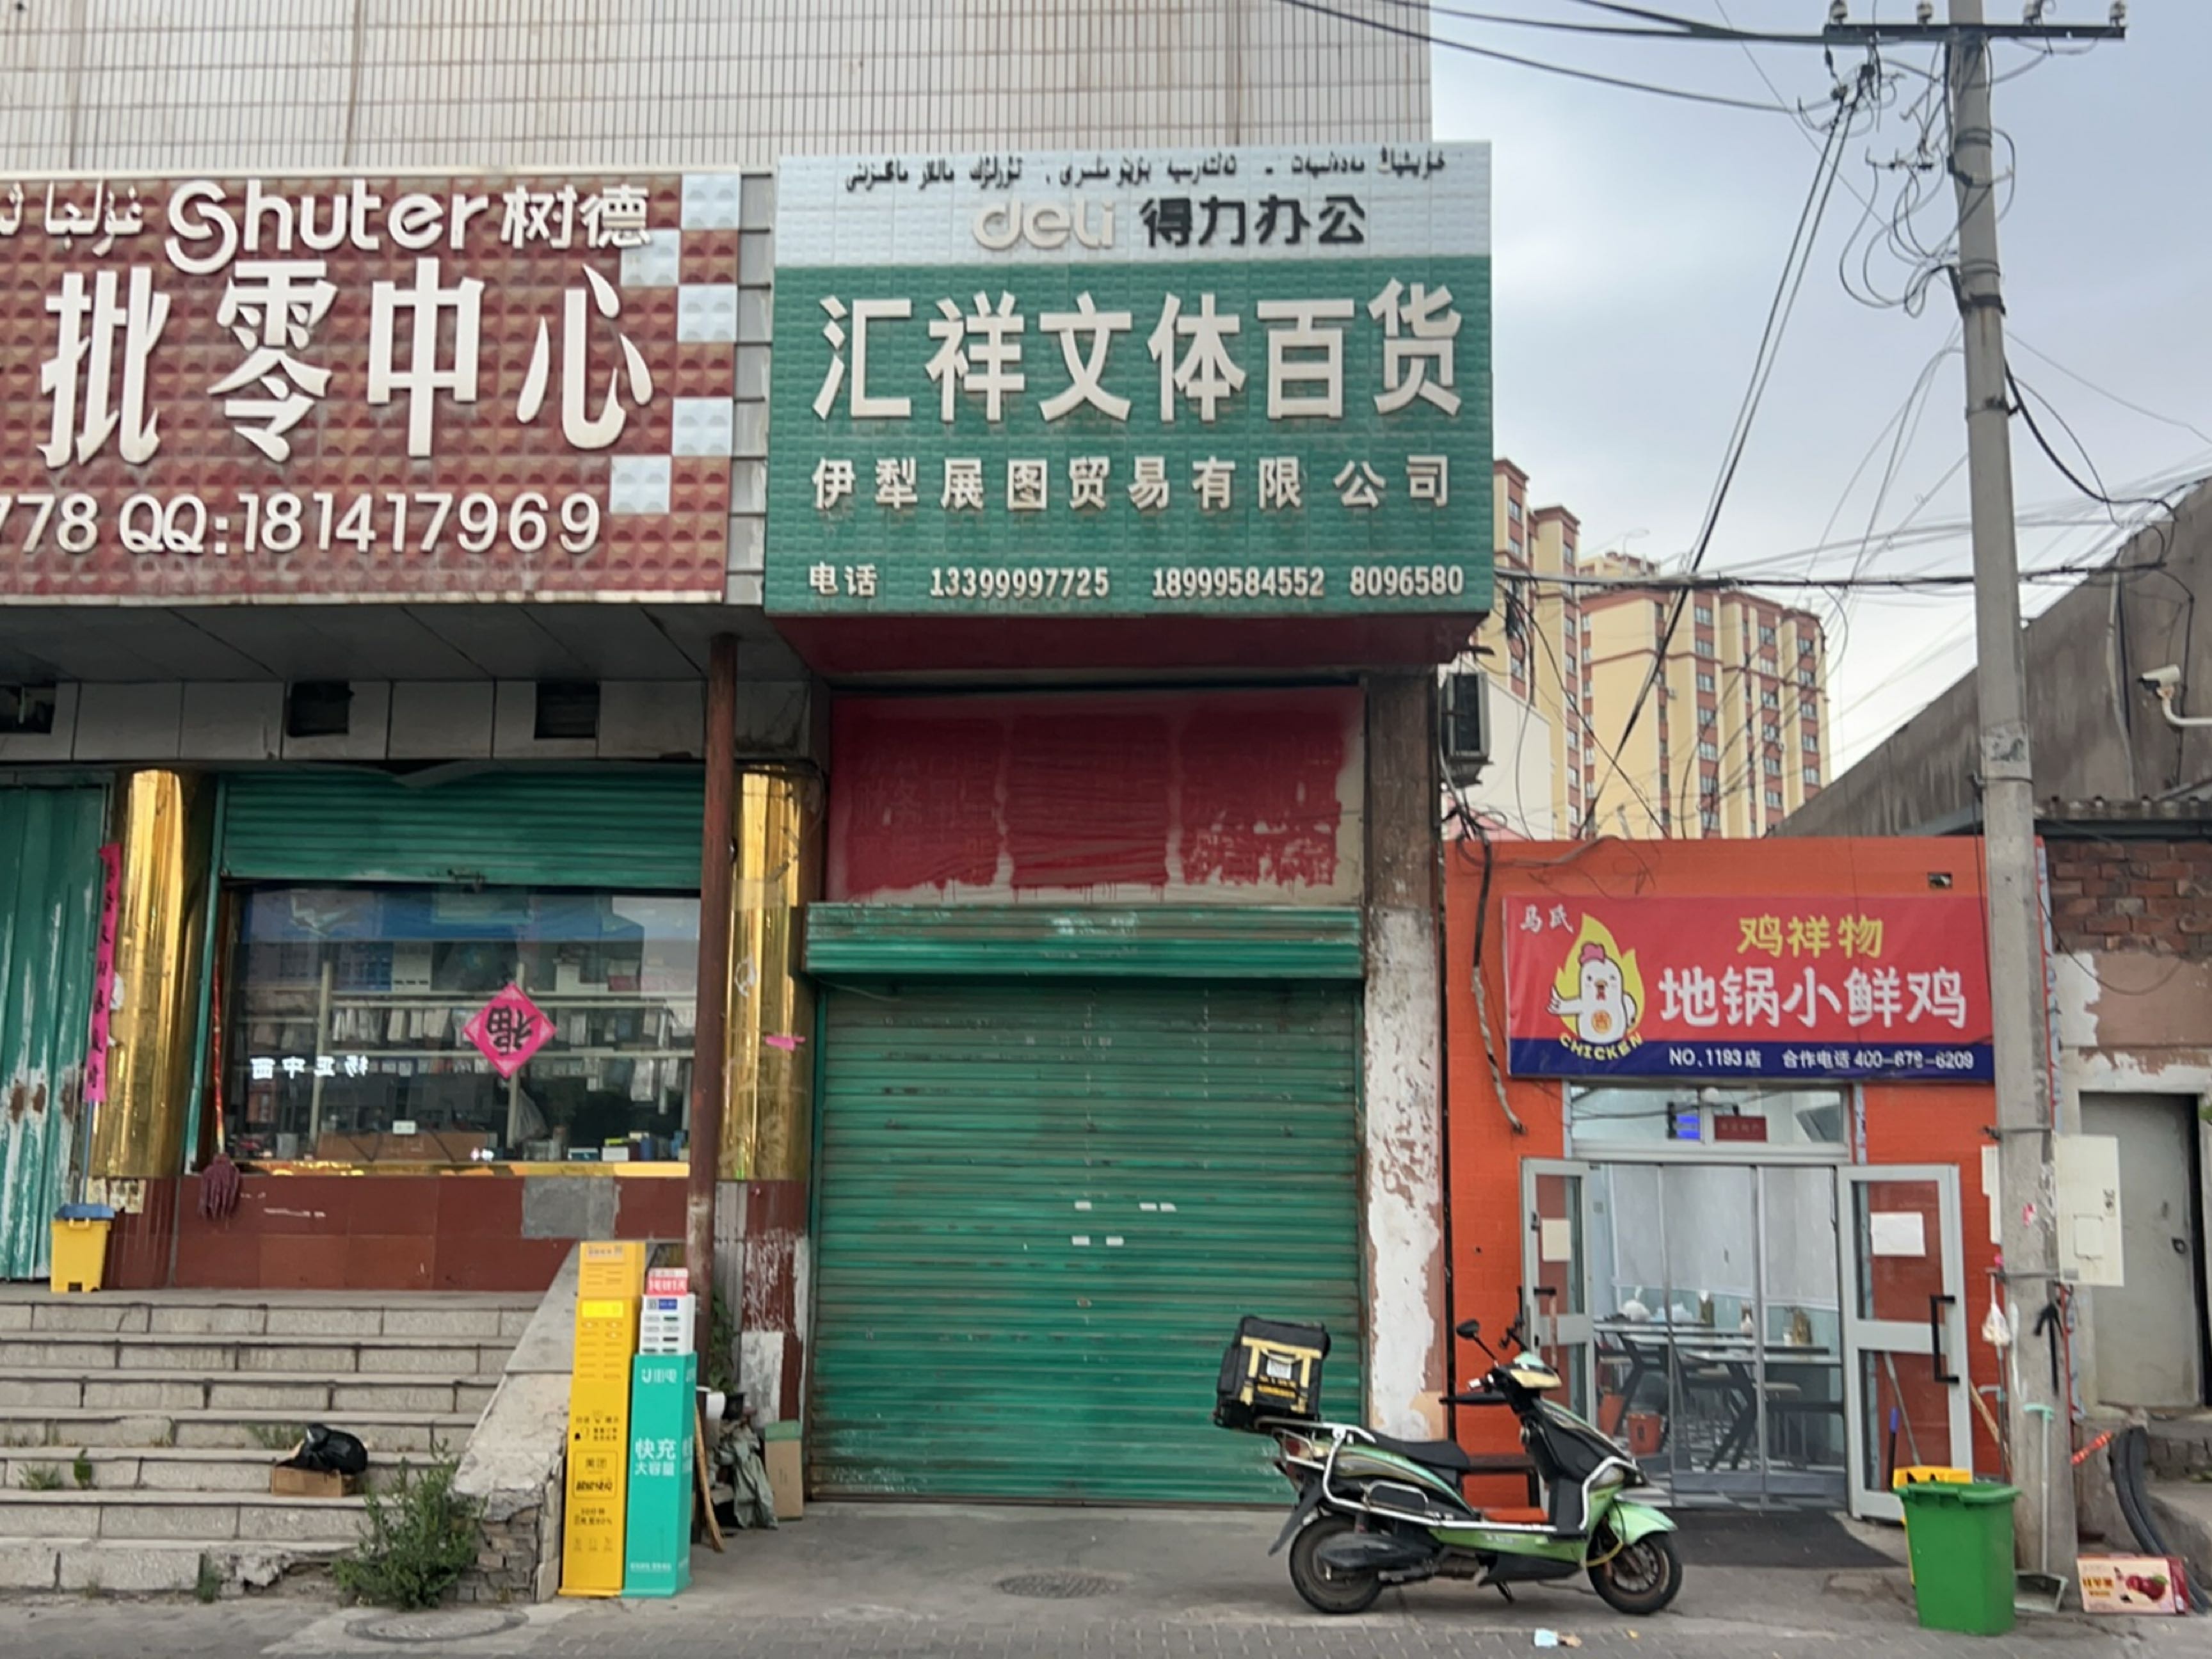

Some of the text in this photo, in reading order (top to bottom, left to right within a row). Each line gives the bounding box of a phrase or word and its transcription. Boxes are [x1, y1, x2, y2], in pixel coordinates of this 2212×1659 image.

[165, 179, 652, 273] Shuter 树德
[972, 194, 1365, 250] deli 得力办公
[37, 257, 653, 468] 批零中心
[812, 277, 1462, 421] 汇祥文体百货
[812, 454, 1448, 509] 伊犁展图贸易有限公司
[810, 561, 1463, 598] 电话 13399997725 18999584552 8096580
[1736, 913, 1883, 959] 鸡祥物
[1658, 965, 1967, 1029] 地锅小鲜鸡
[485, 1004, 537, 1056] 福
[1558, 1031, 1644, 1061] CHICKEN
[634, 1437, 677, 1460] 快充
